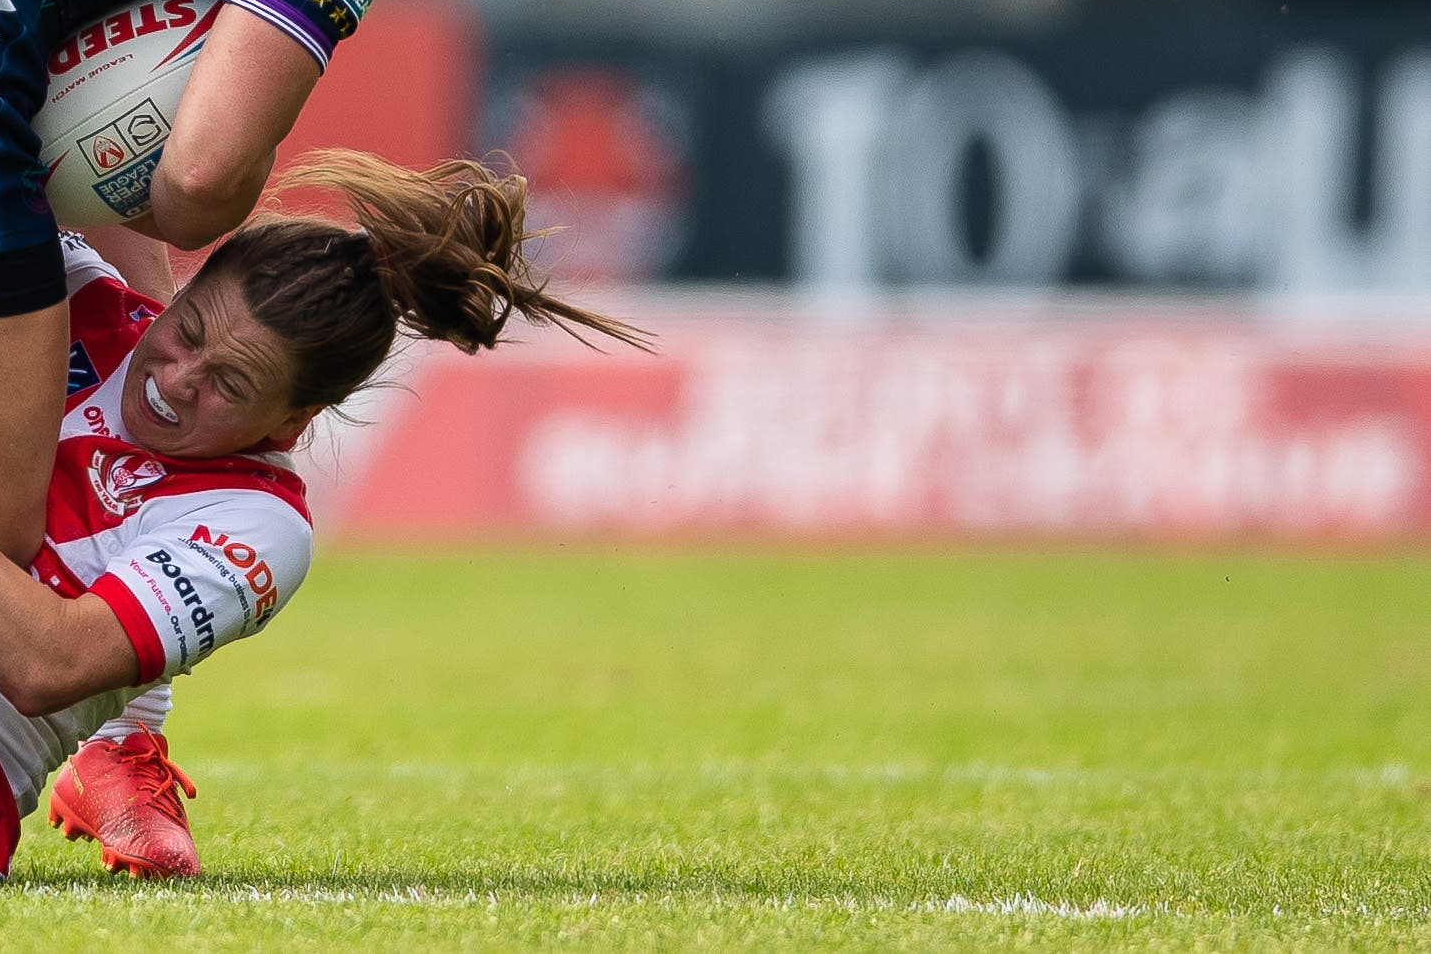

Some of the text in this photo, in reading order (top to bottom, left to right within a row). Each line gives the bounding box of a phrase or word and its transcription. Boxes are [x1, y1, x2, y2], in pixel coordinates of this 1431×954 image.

[51, 52, 134, 104] LEAGUE MATCH
[129, 559, 149, 579] Your
[170, 615, 183, 635] Our
